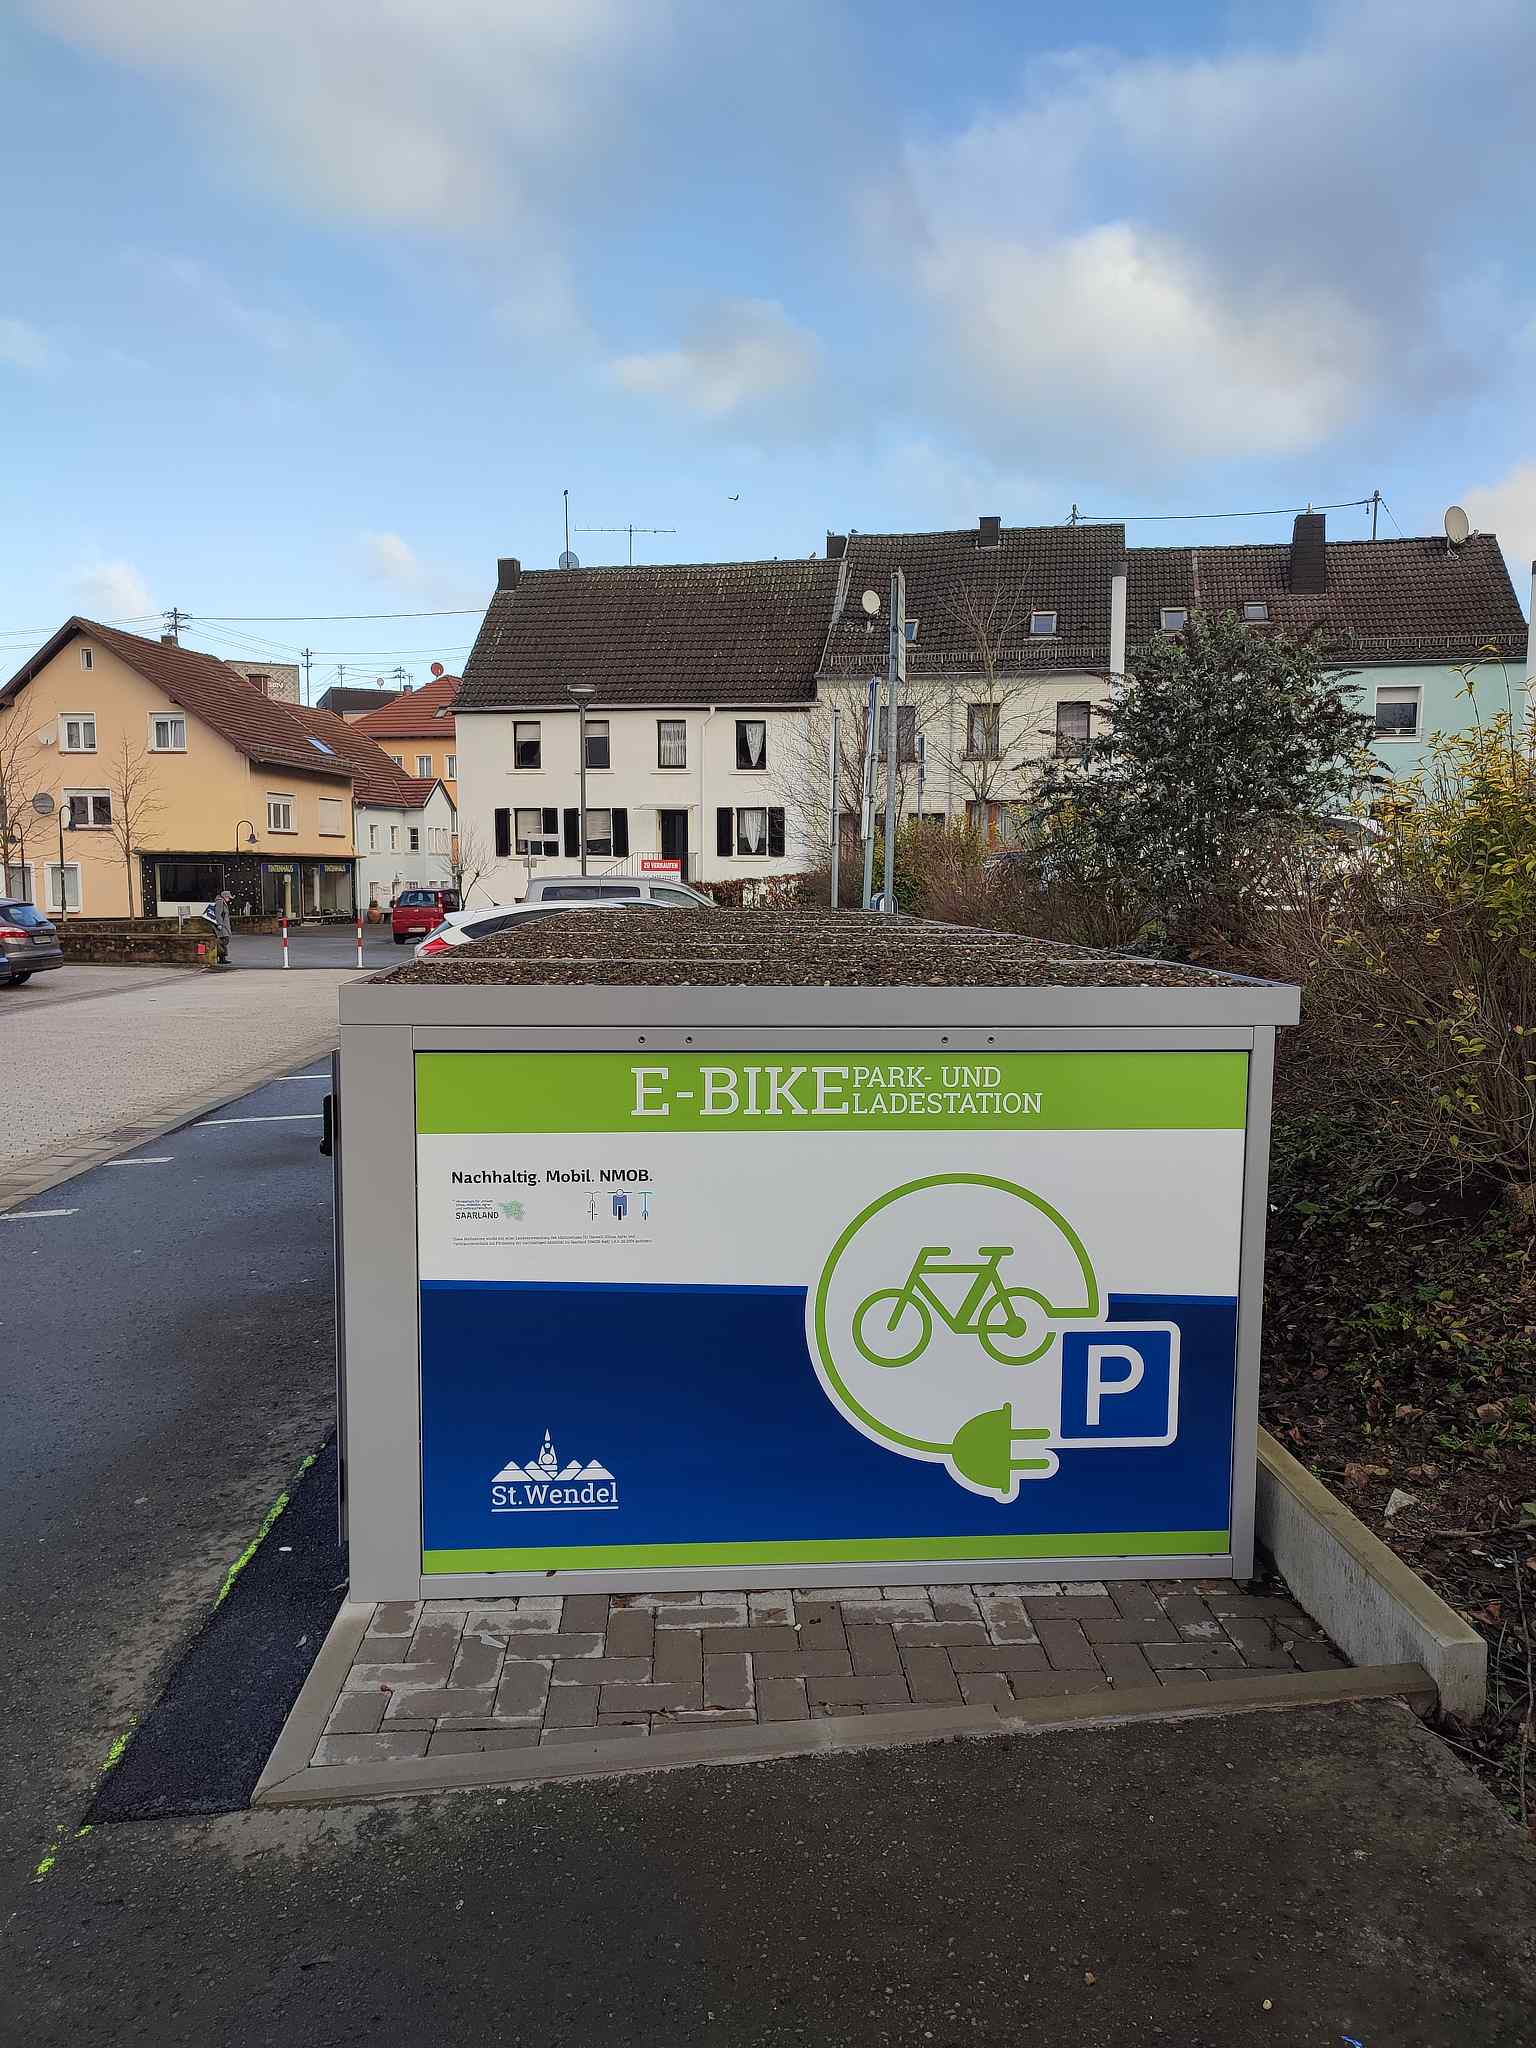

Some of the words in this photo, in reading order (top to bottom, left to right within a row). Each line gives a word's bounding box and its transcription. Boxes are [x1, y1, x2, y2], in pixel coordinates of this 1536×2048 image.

[852, 1065, 933, 1088] PARK-
[942, 1065, 1002, 1088] UND
[630, 1065, 850, 1117] E-BIKE
[852, 1092, 1043, 1115] LADESTATION
[451, 1169, 541, 1187] Nachhaltig.
[546, 1168, 595, 1183] Mobil.
[599, 1169, 653, 1182] NMOB.
[455, 1211, 499, 1220] SAARLAND
[1086, 1344, 1145, 1426] P
